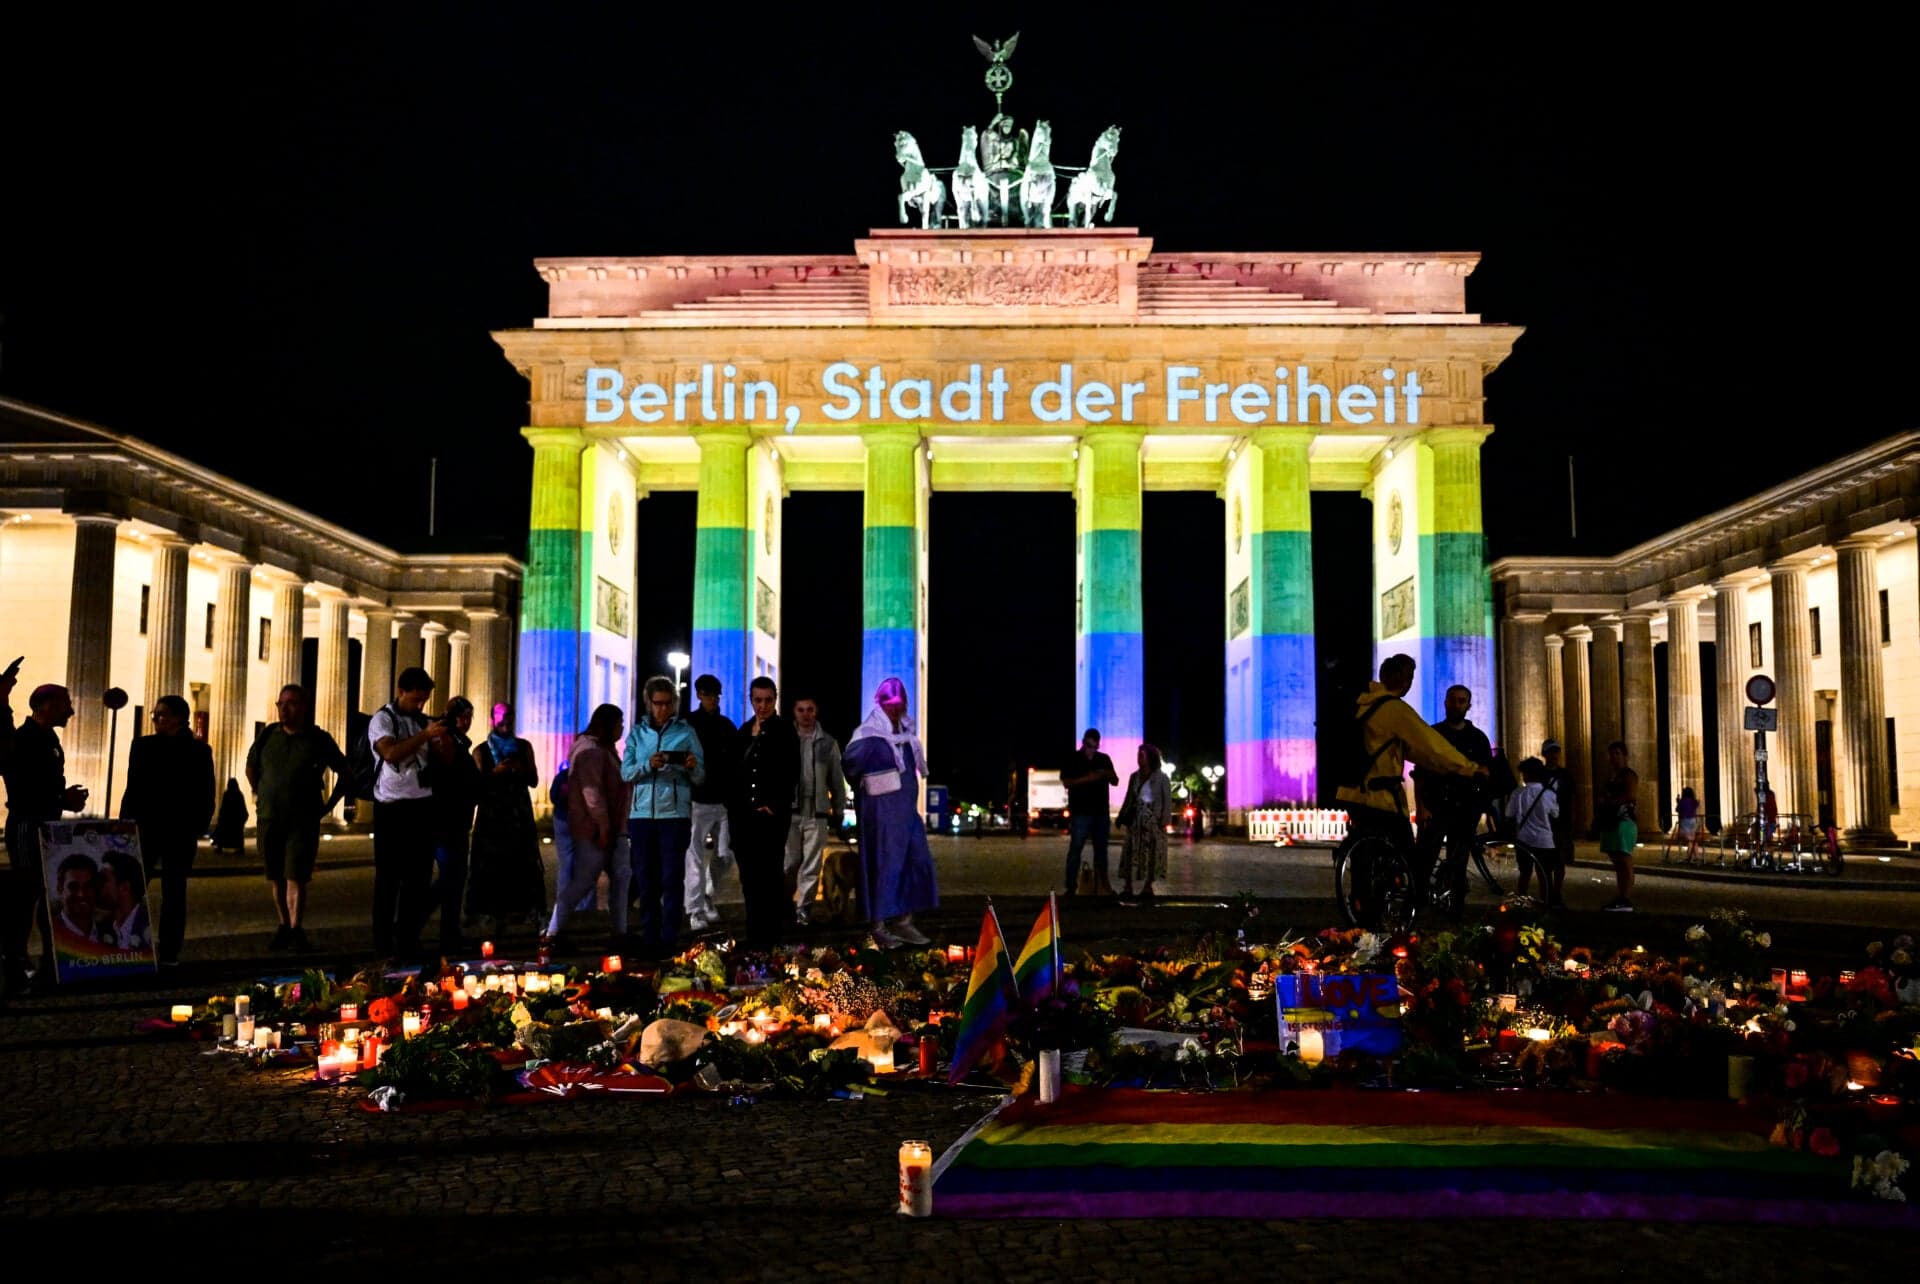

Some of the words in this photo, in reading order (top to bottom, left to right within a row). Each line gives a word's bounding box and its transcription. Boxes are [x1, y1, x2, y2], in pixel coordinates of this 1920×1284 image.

[585, 363, 800, 434] Berlin,
[821, 362, 1009, 420] Stadt
[1030, 363, 1145, 422] der
[1166, 365, 1423, 424] Freiheit
[102, 952, 143, 966] BERLIN
[1301, 974, 1389, 1008] LOVE
